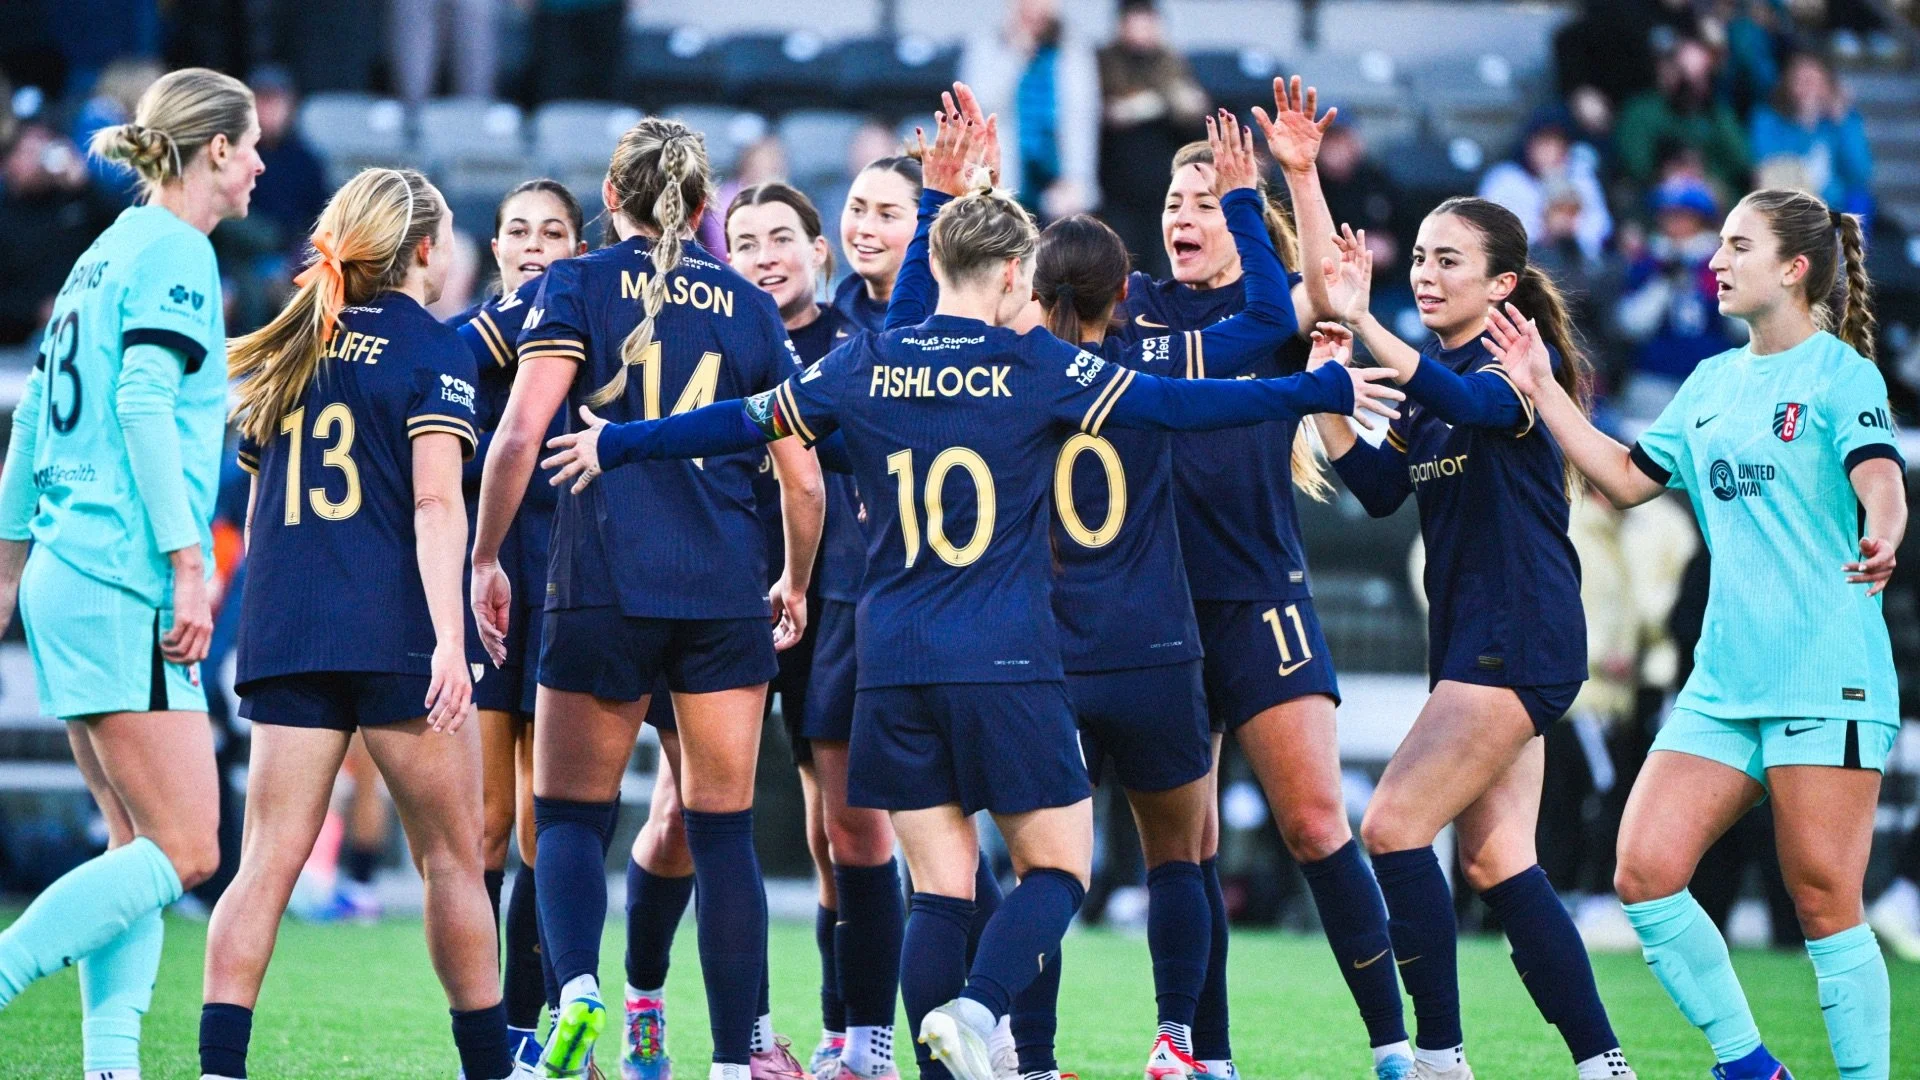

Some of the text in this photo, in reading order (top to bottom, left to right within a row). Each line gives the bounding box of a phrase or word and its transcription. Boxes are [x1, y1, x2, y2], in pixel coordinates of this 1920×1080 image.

[682, 256, 722, 271] CHOICE
[942, 335, 986, 345] CHOICE
[45, 310, 82, 437] 13
[869, 365, 1013, 398] FISHLOCK
[280, 402, 362, 526] 13
[1738, 463, 1775, 481] UNITED
[1738, 481, 1762, 496] WAY
[886, 446, 996, 569] 10
[1262, 604, 1312, 662] 11
